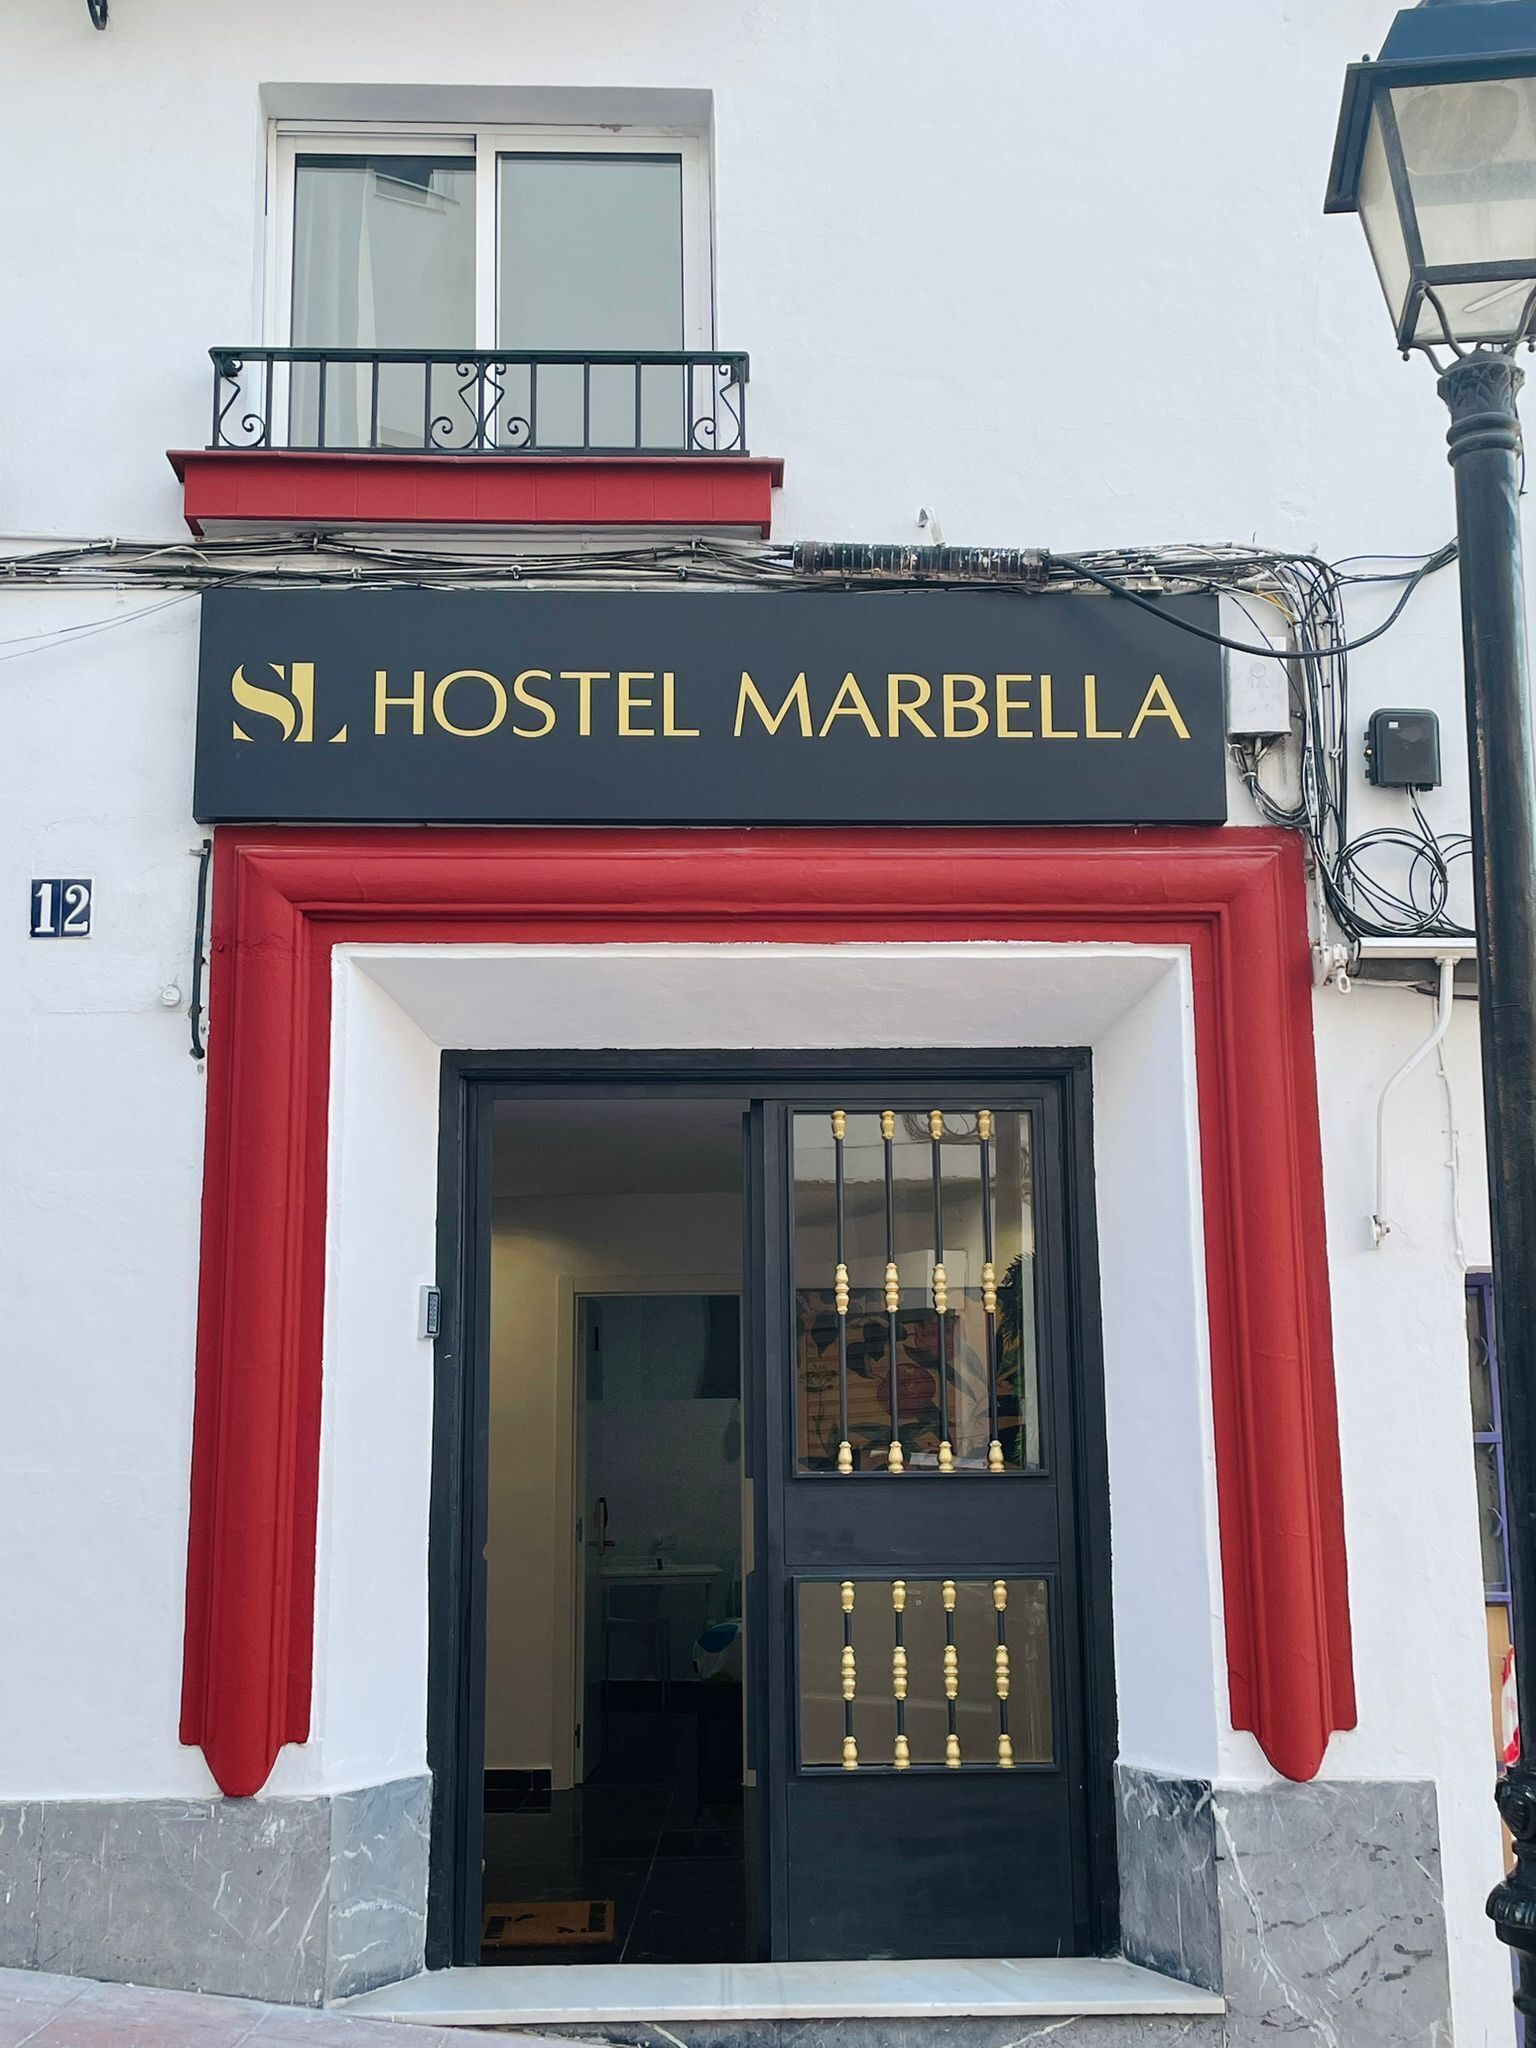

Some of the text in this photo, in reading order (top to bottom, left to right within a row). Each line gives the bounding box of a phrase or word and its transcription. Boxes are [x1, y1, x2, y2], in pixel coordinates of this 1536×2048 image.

[374, 669, 700, 738] HOSTEL
[734, 671, 1191, 740] MARBELLA
[34, 883, 91, 934] 12
